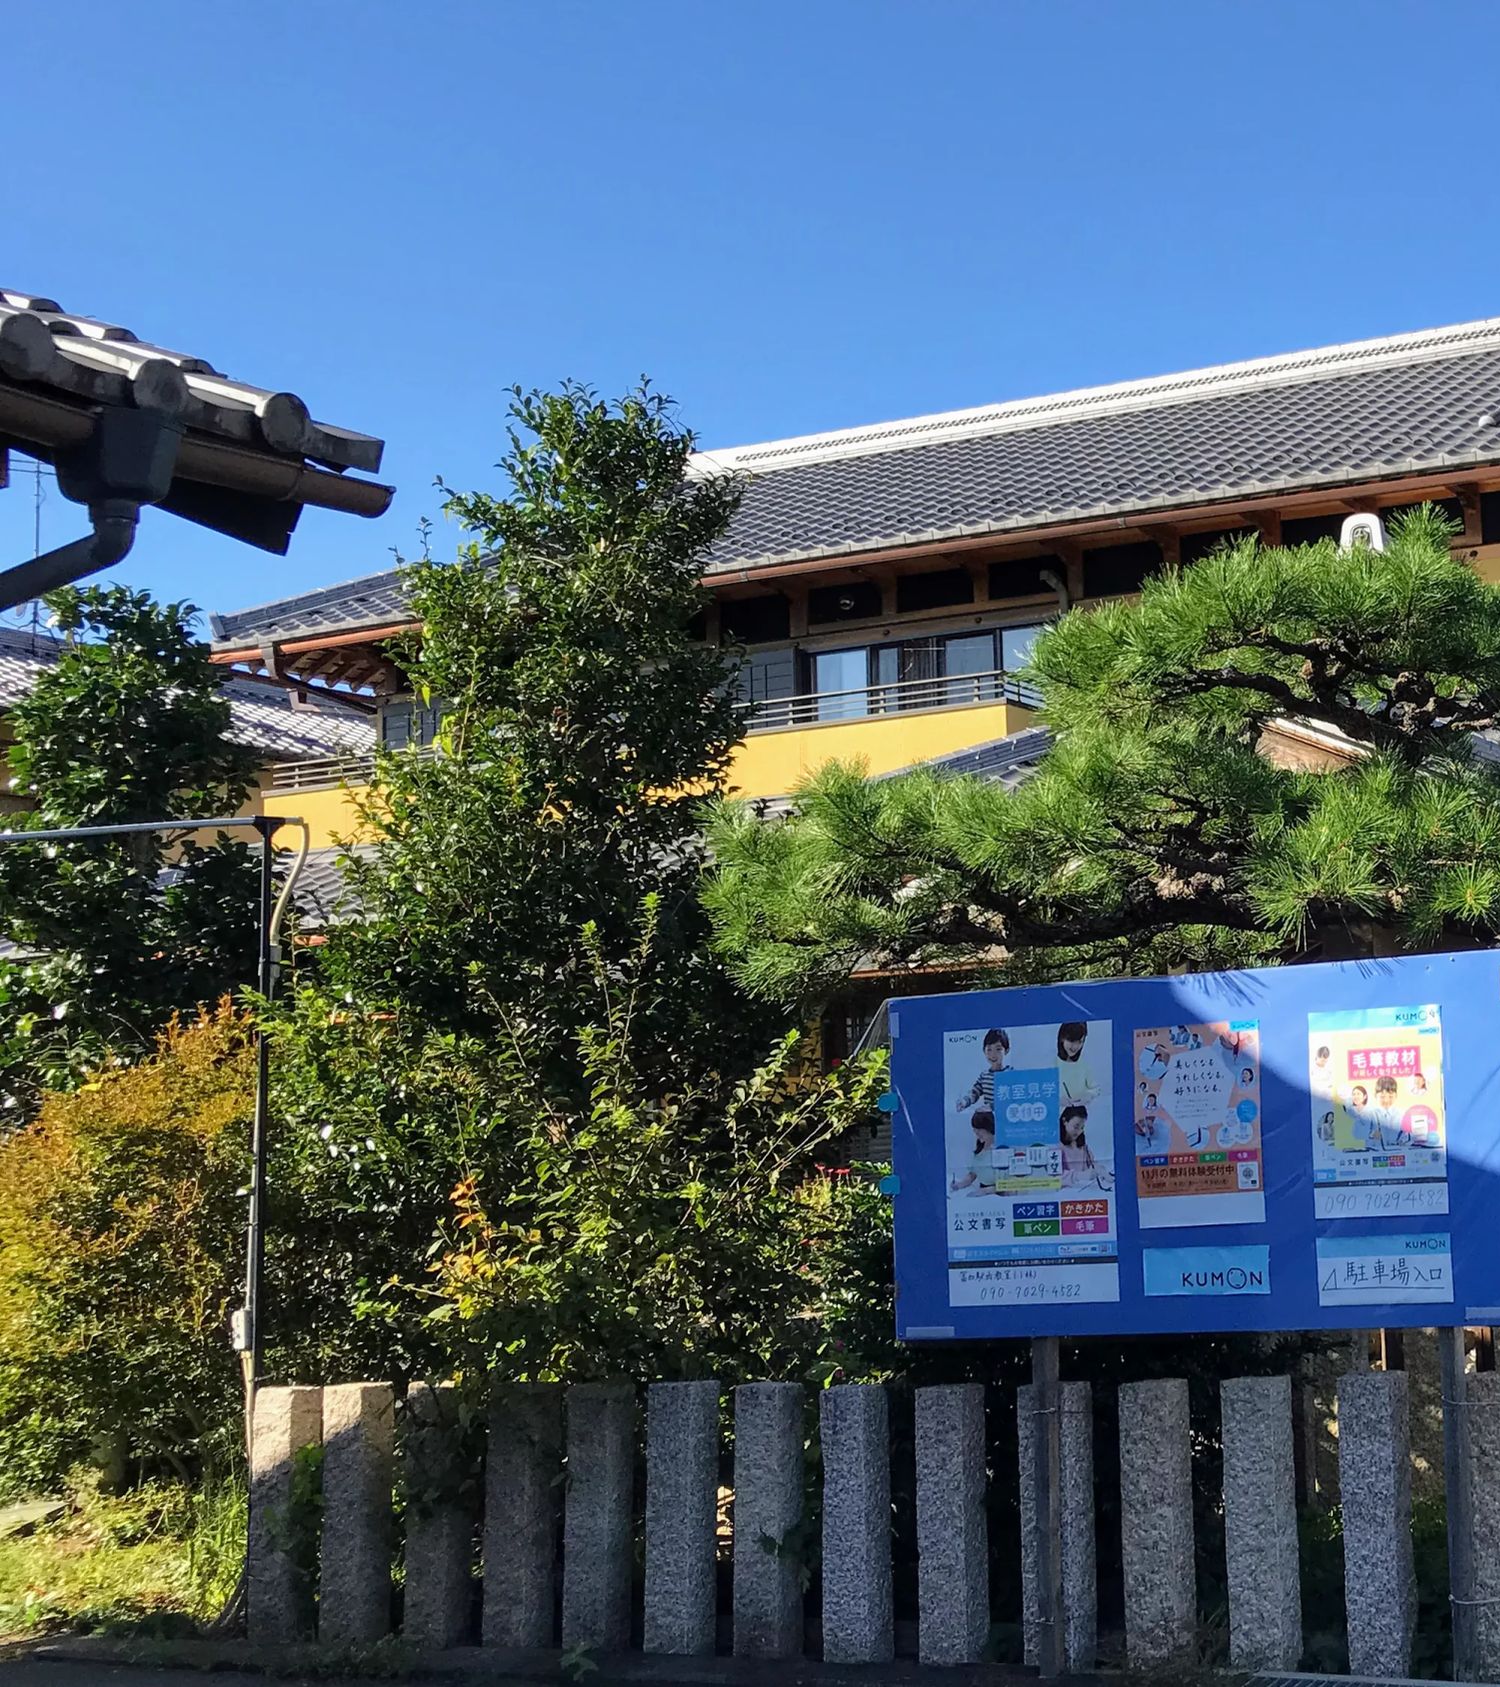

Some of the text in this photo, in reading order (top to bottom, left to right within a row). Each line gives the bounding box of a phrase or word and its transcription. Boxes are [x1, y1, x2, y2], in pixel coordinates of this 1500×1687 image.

[949, 1033, 978, 1044] KUMON
[1174, 1058, 1216, 1070] 美しくなる
[1352, 1050, 1417, 1069] 毛筆教材
[997, 1081, 1057, 1101] 教室見学
[1008, 1103, 1045, 1121] 受付中
[1141, 1164, 1236, 1181] 11月の無料体験受付中
[1017, 1206, 1056, 1217] ペン習字
[1065, 1202, 1106, 1216] かきかた
[954, 1217, 1006, 1232] 公文書写
[1024, 1223, 1053, 1235] 筆ペン
[1076, 1220, 1096, 1232] 毛筆
[1405, 1238, 1446, 1251] KUMON
[1182, 1267, 1263, 1290] KUMON
[1344, 1257, 1442, 1286] 駐車場入口
